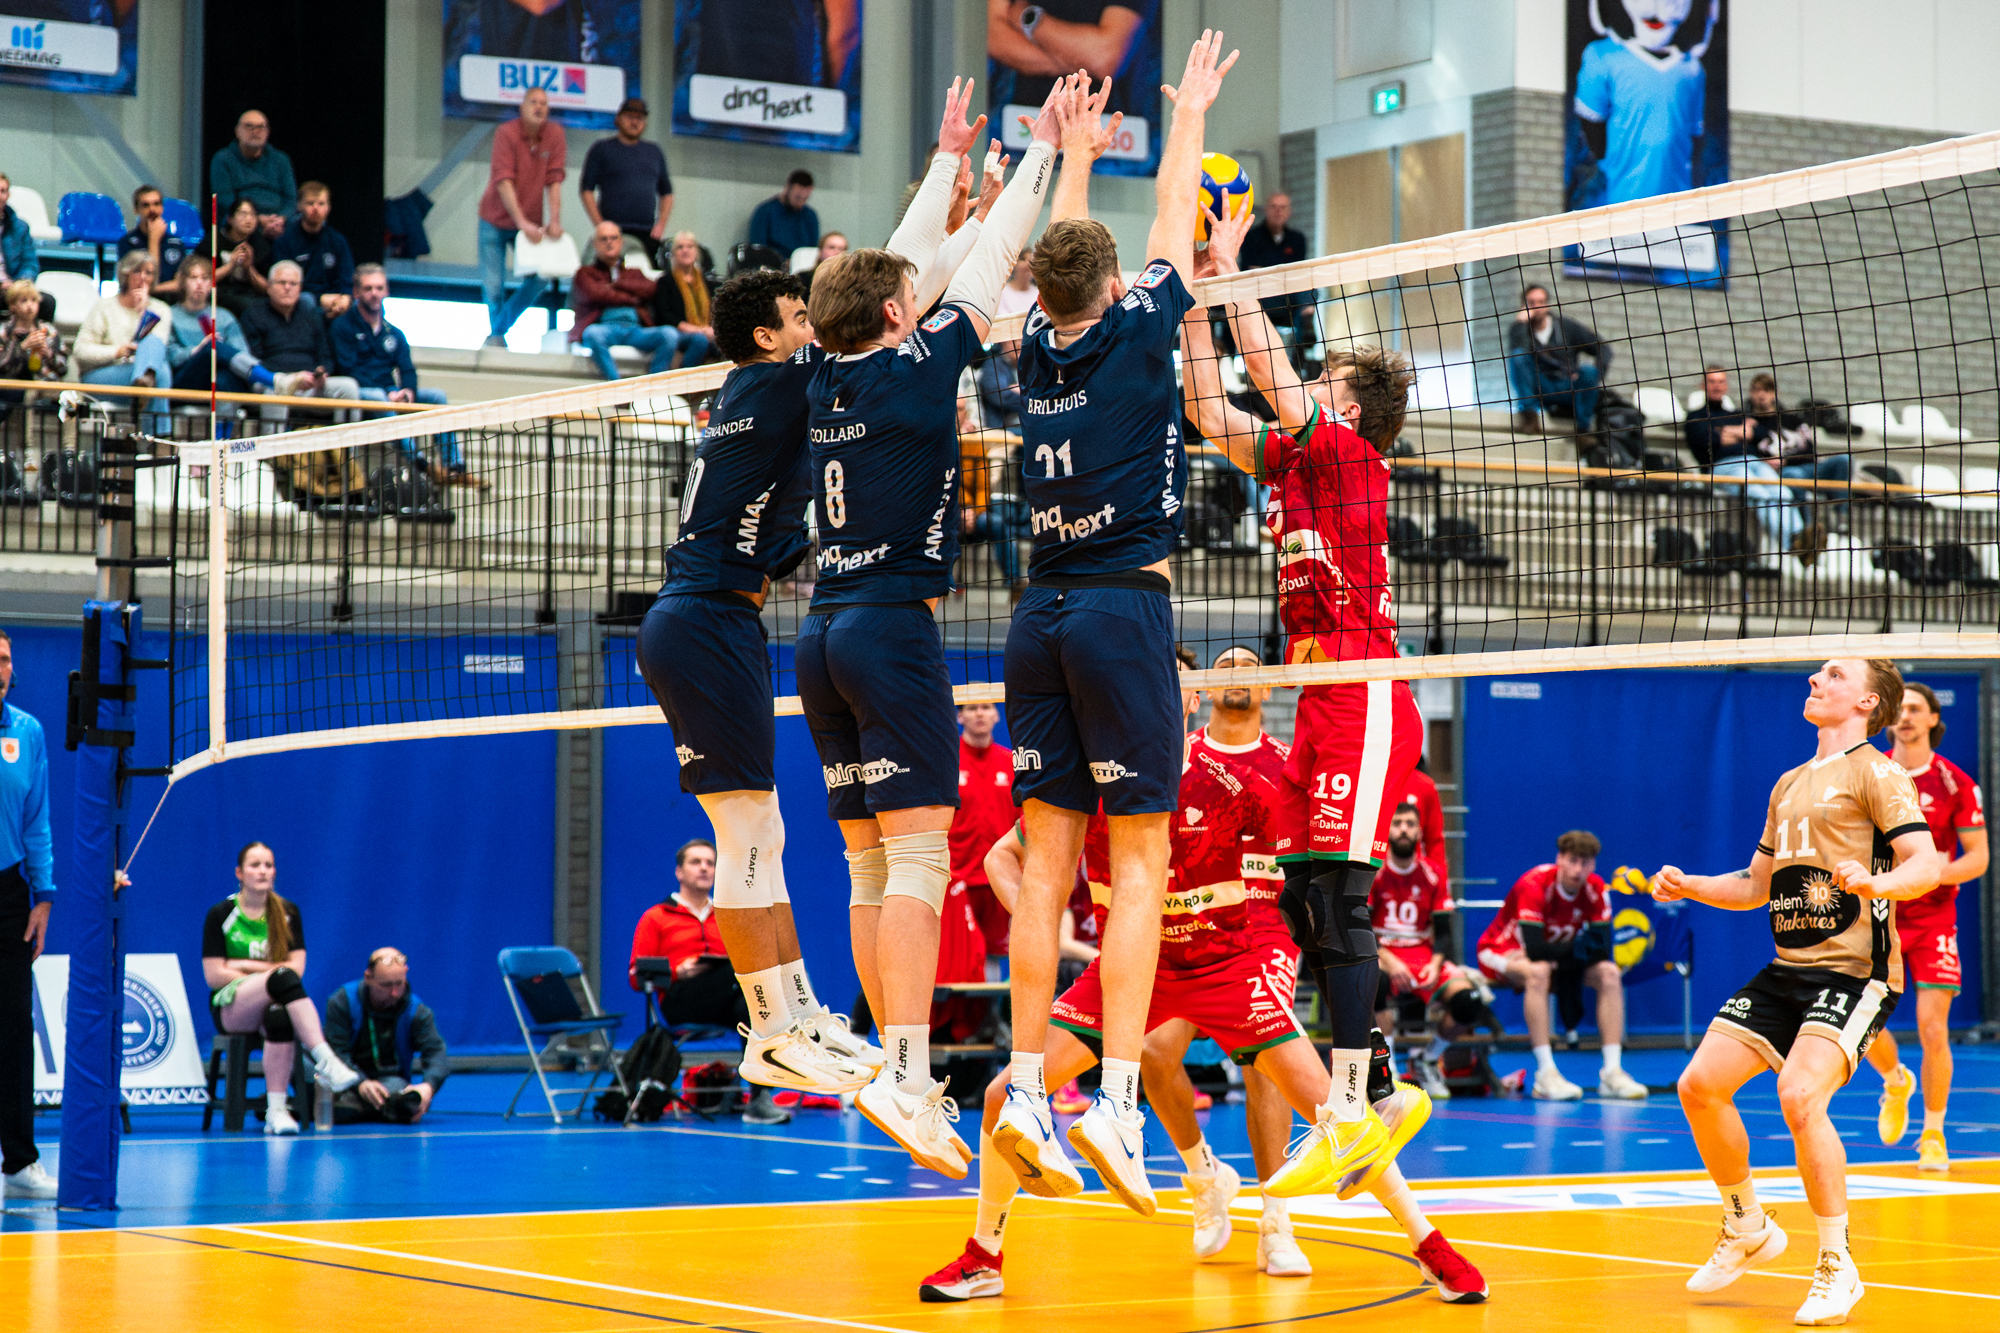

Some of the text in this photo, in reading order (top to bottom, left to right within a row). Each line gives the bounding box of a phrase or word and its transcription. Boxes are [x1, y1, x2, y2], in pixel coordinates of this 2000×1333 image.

[0, 50, 61, 65] EDMAG
[500, 62, 558, 92] BUZ
[762, 92, 813, 121] next
[1033, 164, 1047, 195] CRAFT
[1028, 390, 1087, 415] BRILHUIS
[810, 423, 867, 443] COLLARD
[824, 460, 846, 528] 8
[1058, 503, 1115, 542] next
[837, 543, 892, 574] next
[1314, 772, 1351, 801] 19
[1313, 835, 1335, 843] CRAFT
[1775, 817, 1816, 860] 11
[747, 846, 758, 880] CRAFT
[1164, 895, 1200, 910] YARD
[1811, 886, 1828, 900] 10
[1385, 900, 1418, 925] 10
[1271, 948, 1295, 978] 25
[754, 984, 767, 1009] CRAFT
[793, 973, 806, 996] CRAFT
[1813, 989, 1848, 1016] 11
[1256, 1022, 1280, 1035] CRAFT
[898, 1037, 908, 1070] CRAFT
[1349, 1062, 1357, 1093] CRAFT
